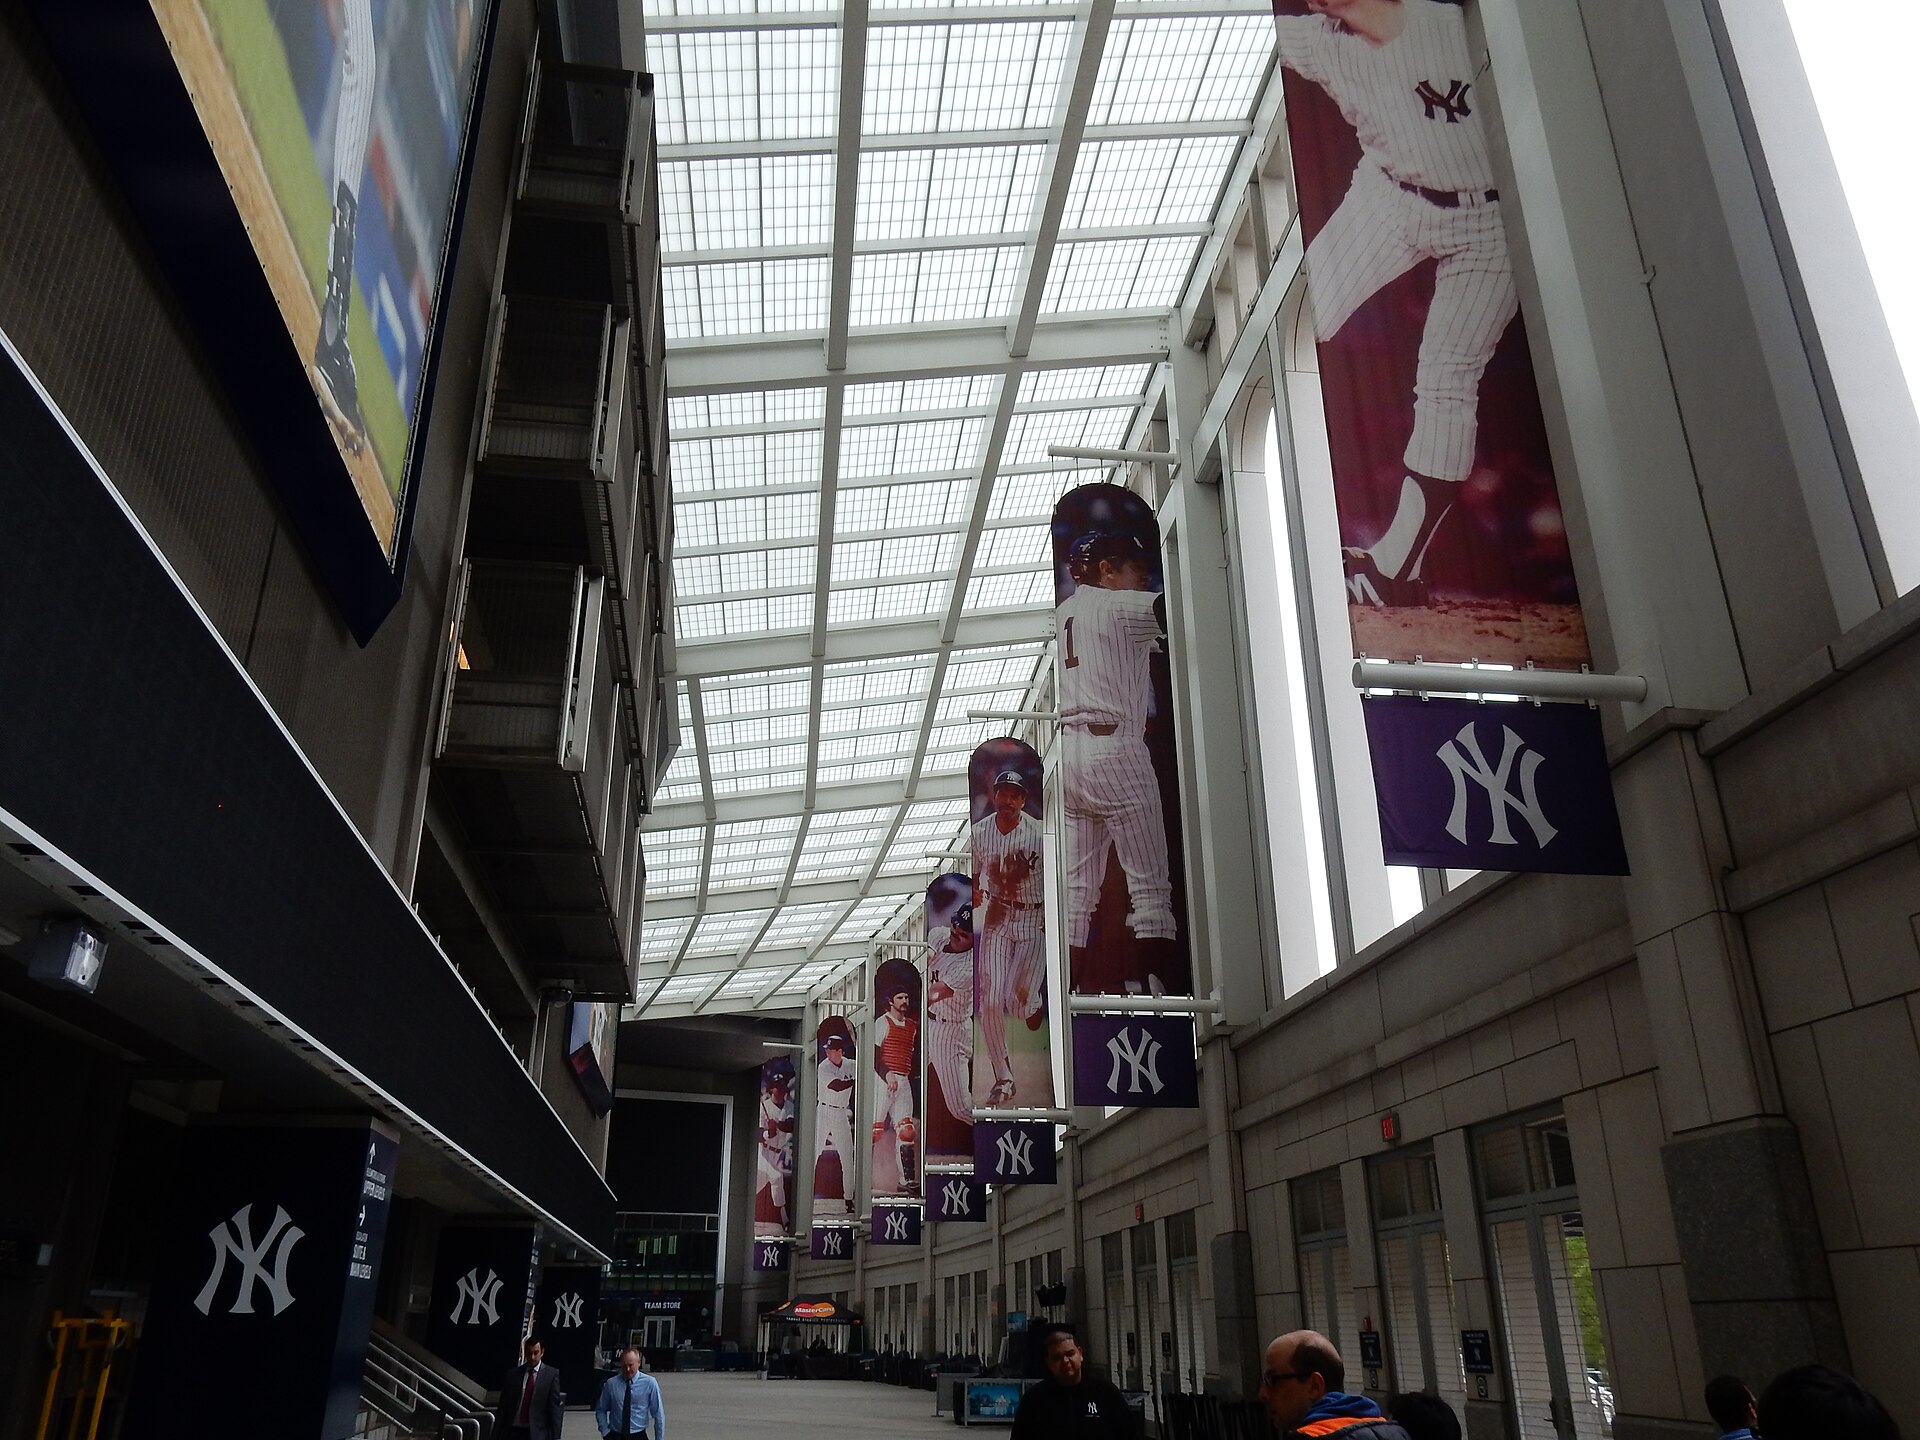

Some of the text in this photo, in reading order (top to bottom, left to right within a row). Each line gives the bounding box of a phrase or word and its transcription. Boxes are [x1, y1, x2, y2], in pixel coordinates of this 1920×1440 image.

[1414, 79, 1472, 124] NY
[1063, 616, 1080, 670] 1
[1435, 720, 1559, 849] NY
[1106, 1026, 1165, 1095] NY
[995, 1129, 1035, 1176] NY
[941, 1179, 970, 1216] NY
[822, 1231, 843, 1256] NY
[884, 1211, 908, 1240] NY
[193, 1202, 306, 1317] NY
[762, 1245, 780, 1268] NY
[449, 1267, 505, 1326] NY
[551, 1292, 585, 1328] NY
[644, 1301, 682, 1309] TEAM STORE
